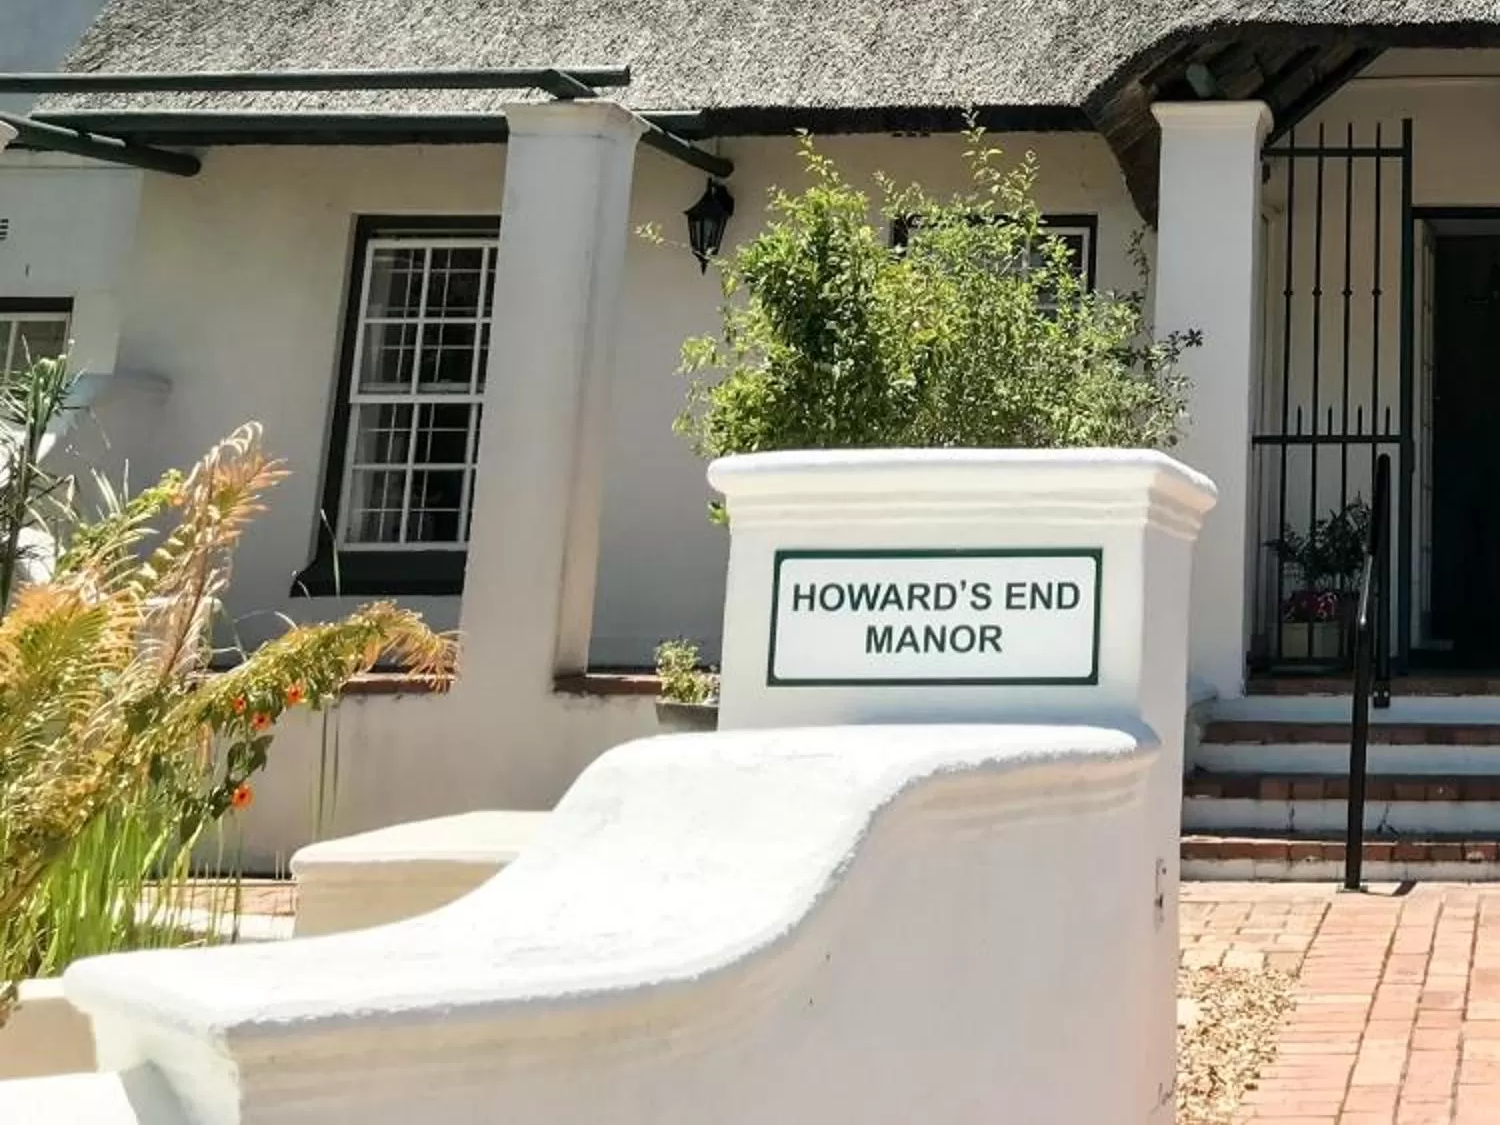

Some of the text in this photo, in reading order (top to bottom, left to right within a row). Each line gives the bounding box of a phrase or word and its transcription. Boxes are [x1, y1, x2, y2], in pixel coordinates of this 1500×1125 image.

[792, 580, 1081, 612] HOWARD'S END
[865, 625, 1003, 653] MANOR
